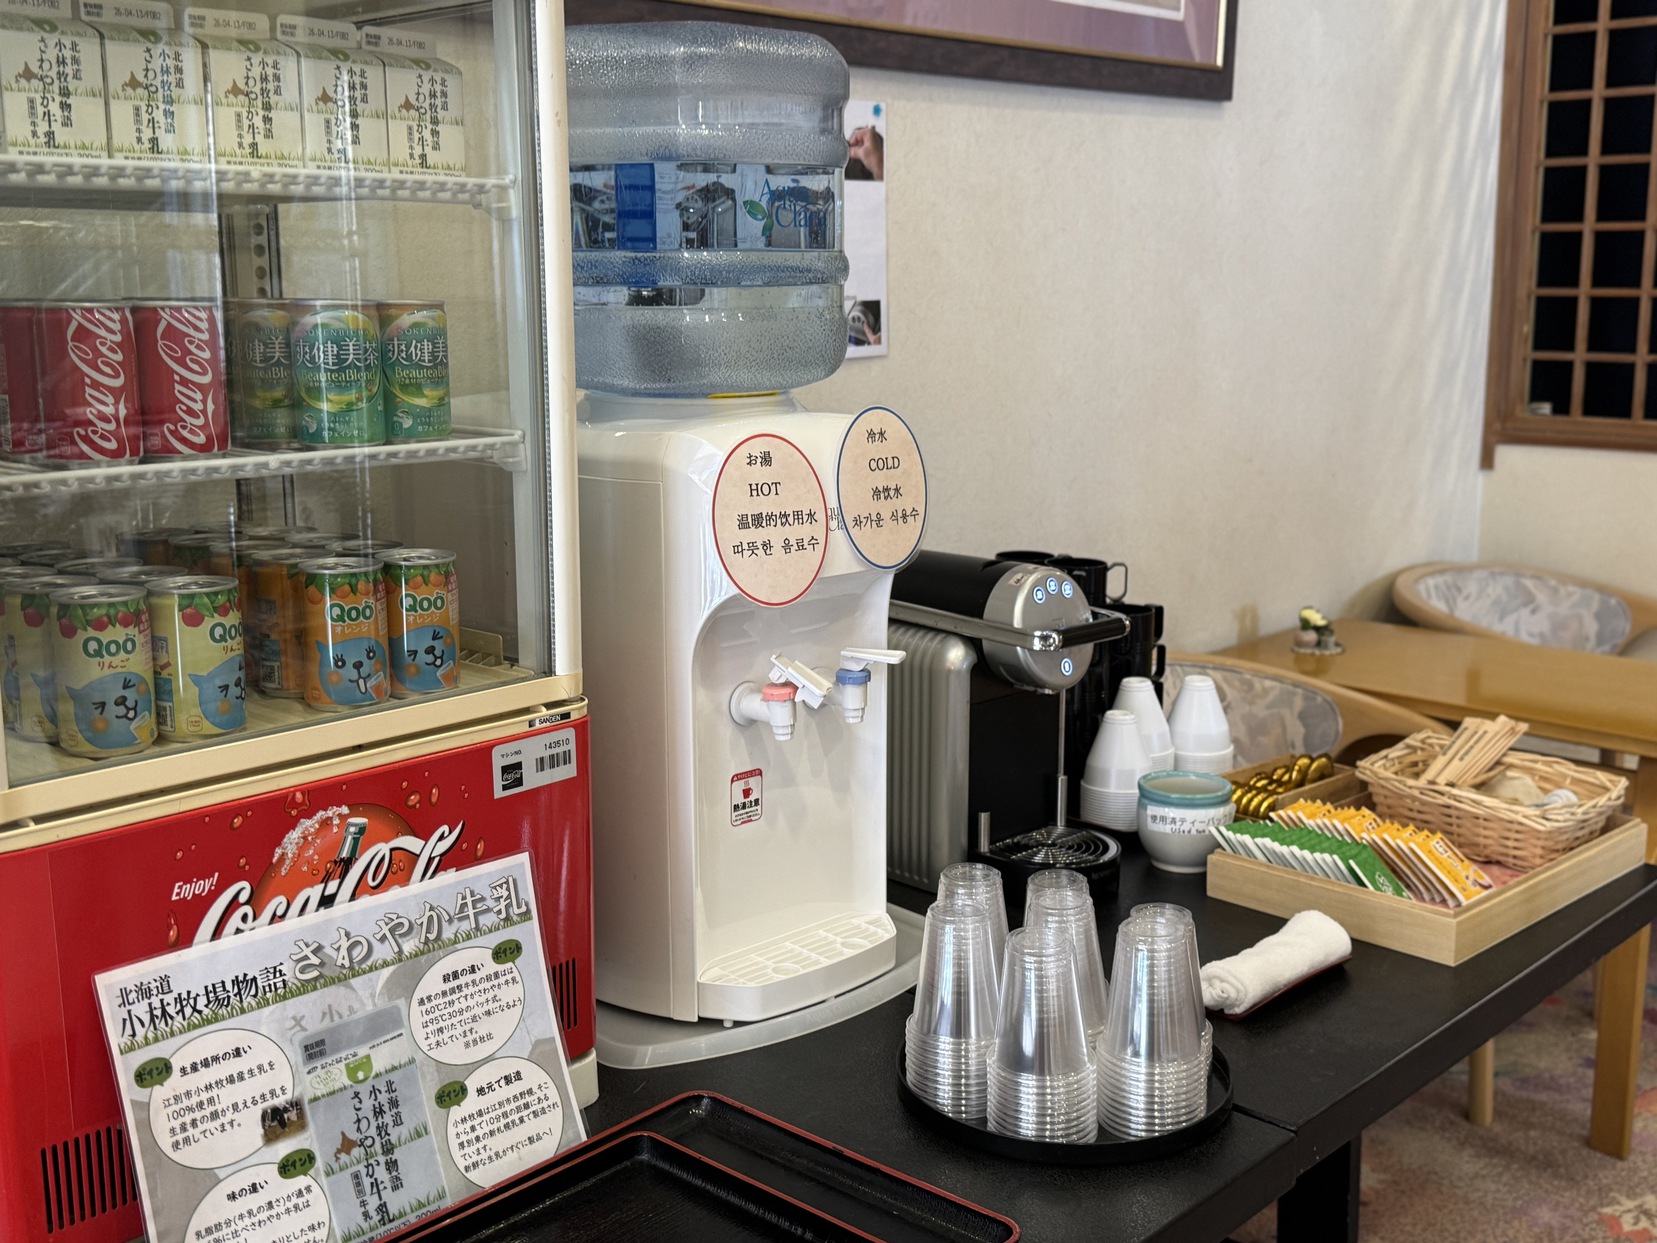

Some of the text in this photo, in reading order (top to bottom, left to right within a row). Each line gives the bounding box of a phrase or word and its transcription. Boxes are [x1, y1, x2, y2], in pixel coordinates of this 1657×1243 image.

[70, 40, 82, 81] 北海道
[173, 50, 184, 89] 北海道
[37, 36, 59, 149] さわやか牛乳
[54, 38, 73, 128] 小林牧場物語
[159, 48, 176, 134] 小林牧場物語
[271, 59, 282, 96] 北海道
[359, 68, 368, 104] 北海道
[439, 76, 448, 112] 北海道
[142, 46, 162, 154] さわやか牛乳
[243, 55, 262, 158] さわやか牛乳
[258, 57, 274, 140] 小林牧場物語
[347, 65, 360, 146] 小林牧場物語
[428, 74, 440, 152] 小林牧場物語
[415, 72, 430, 169] さわやか牛乳
[295, 337, 379, 369] 爽健美茶
[66, 307, 126, 459] Coca-Cola
[157, 307, 213, 454] Coca-Cola
[301, 369, 377, 381] BeauteaBlend
[866, 427, 887, 444] 冷水
[746, 450, 773, 468] お湯
[868, 456, 900, 471] COLD
[748, 481, 781, 498] HOT
[871, 483, 903, 501] 冷饮水
[736, 508, 818, 531] 温暖的饮用水
[852, 512, 884, 531] 차가운
[889, 506, 920, 526] 식용수
[732, 535, 820, 559] 따뜻한 음료수
[326, 602, 374, 624] Qoo
[400, 592, 446, 614] Qoo
[407, 613, 440, 624] オレンジ
[335, 622, 369, 635] オレンジ
[82, 636, 137, 659] Qoo
[98, 658, 130, 671] りんご
[544, 737, 570, 751] 143510
[171, 872, 219, 901] Enjoy!
[289, 875, 528, 981] さわやか牛乳
[493, 944, 522, 960] ポイント
[442, 962, 484, 984] 殺菌の違い
[116, 974, 174, 1009] 北海道
[120, 962, 288, 1040] 小林牧場物語
[136, 1062, 172, 1083] ポイント
[179, 1044, 252, 1078] 生産場所の違い
[162, 1060, 276, 1109] 江別市小林牧場産生乳を
[436, 1084, 468, 1105] ポイント
[476, 1070, 524, 1098] 地元で製造
[169, 1085, 288, 1138] 生産者の顔が見える生乳を
[384, 1079, 404, 1128] 北海道
[171, 1118, 241, 1152] 使用しています。
[369, 1084, 404, 1193] 小林牧場物語
[280, 1153, 315, 1175] ポイント
[351, 1090, 395, 1227] さわやか牛乳
[226, 1180, 268, 1203] 味の違い
[359, 1199, 373, 1222] 牛乳
